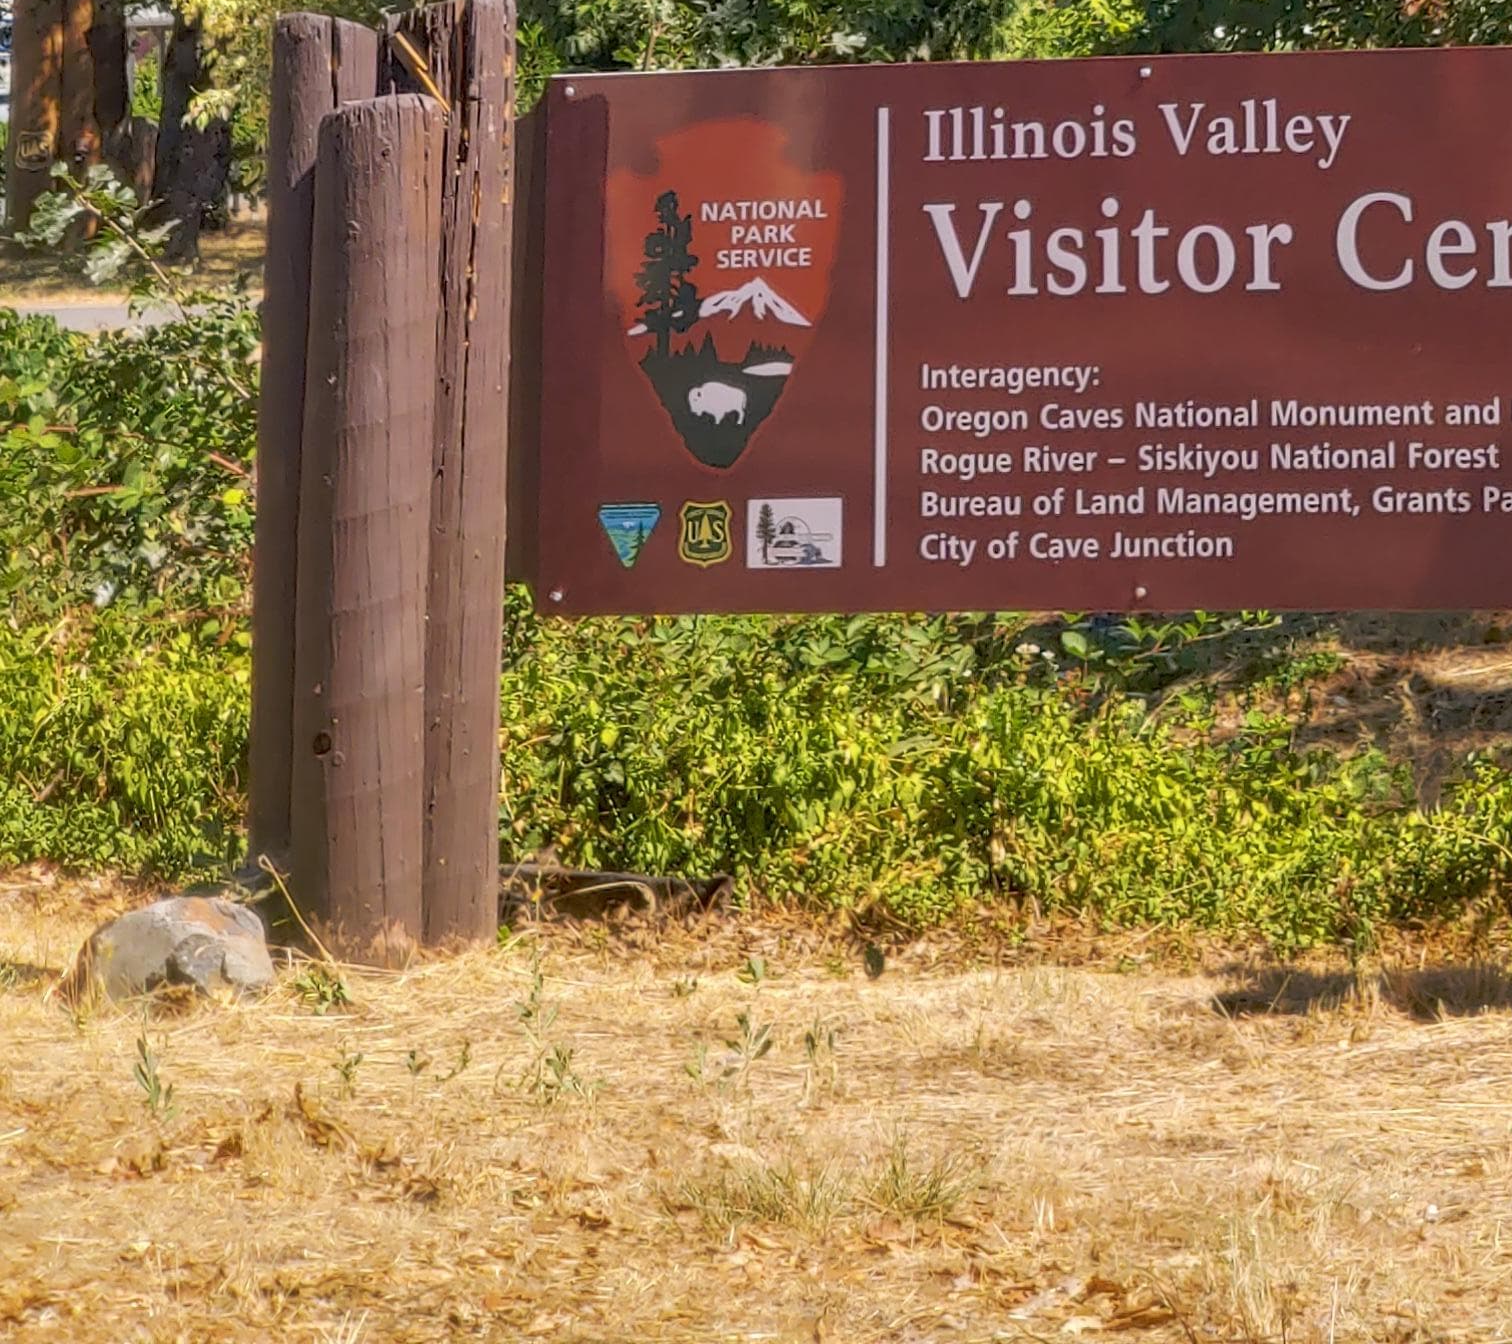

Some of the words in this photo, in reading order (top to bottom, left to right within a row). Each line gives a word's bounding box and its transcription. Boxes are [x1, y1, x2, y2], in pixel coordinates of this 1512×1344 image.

[923, 104, 1136, 161] Illinois
[1158, 98, 1351, 169] Valley
[701, 199, 828, 222] NATIONAL
[731, 223, 796, 245] PARK
[922, 197, 1293, 298] Visitor
[717, 247, 812, 269] SERVICE
[921, 363, 1101, 395] Interagency:
[921, 405, 1028, 438] Oregon
[1040, 403, 1124, 430] Caves
[1135, 399, 1258, 428] National
[1271, 400, 1434, 426] Monument
[1445, 396, 1500, 425] and
[921, 448, 1012, 481] Rogue
[1024, 445, 1098, 472] River
[1139, 442, 1258, 478] Siskiyou
[1271, 441, 1395, 470] National
[1408, 442, 1500, 469] Forest
[921, 491, 1022, 517] Bureau
[1033, 487, 1065, 516] of
[1076, 486, 1145, 515] Land
[1157, 487, 1360, 521] Management,
[1372, 486, 1471, 513] Grants
[920, 532, 977, 567] City
[987, 530, 1019, 559] of
[1029, 532, 1100, 559] Cave
[1110, 529, 1233, 558] Junction
